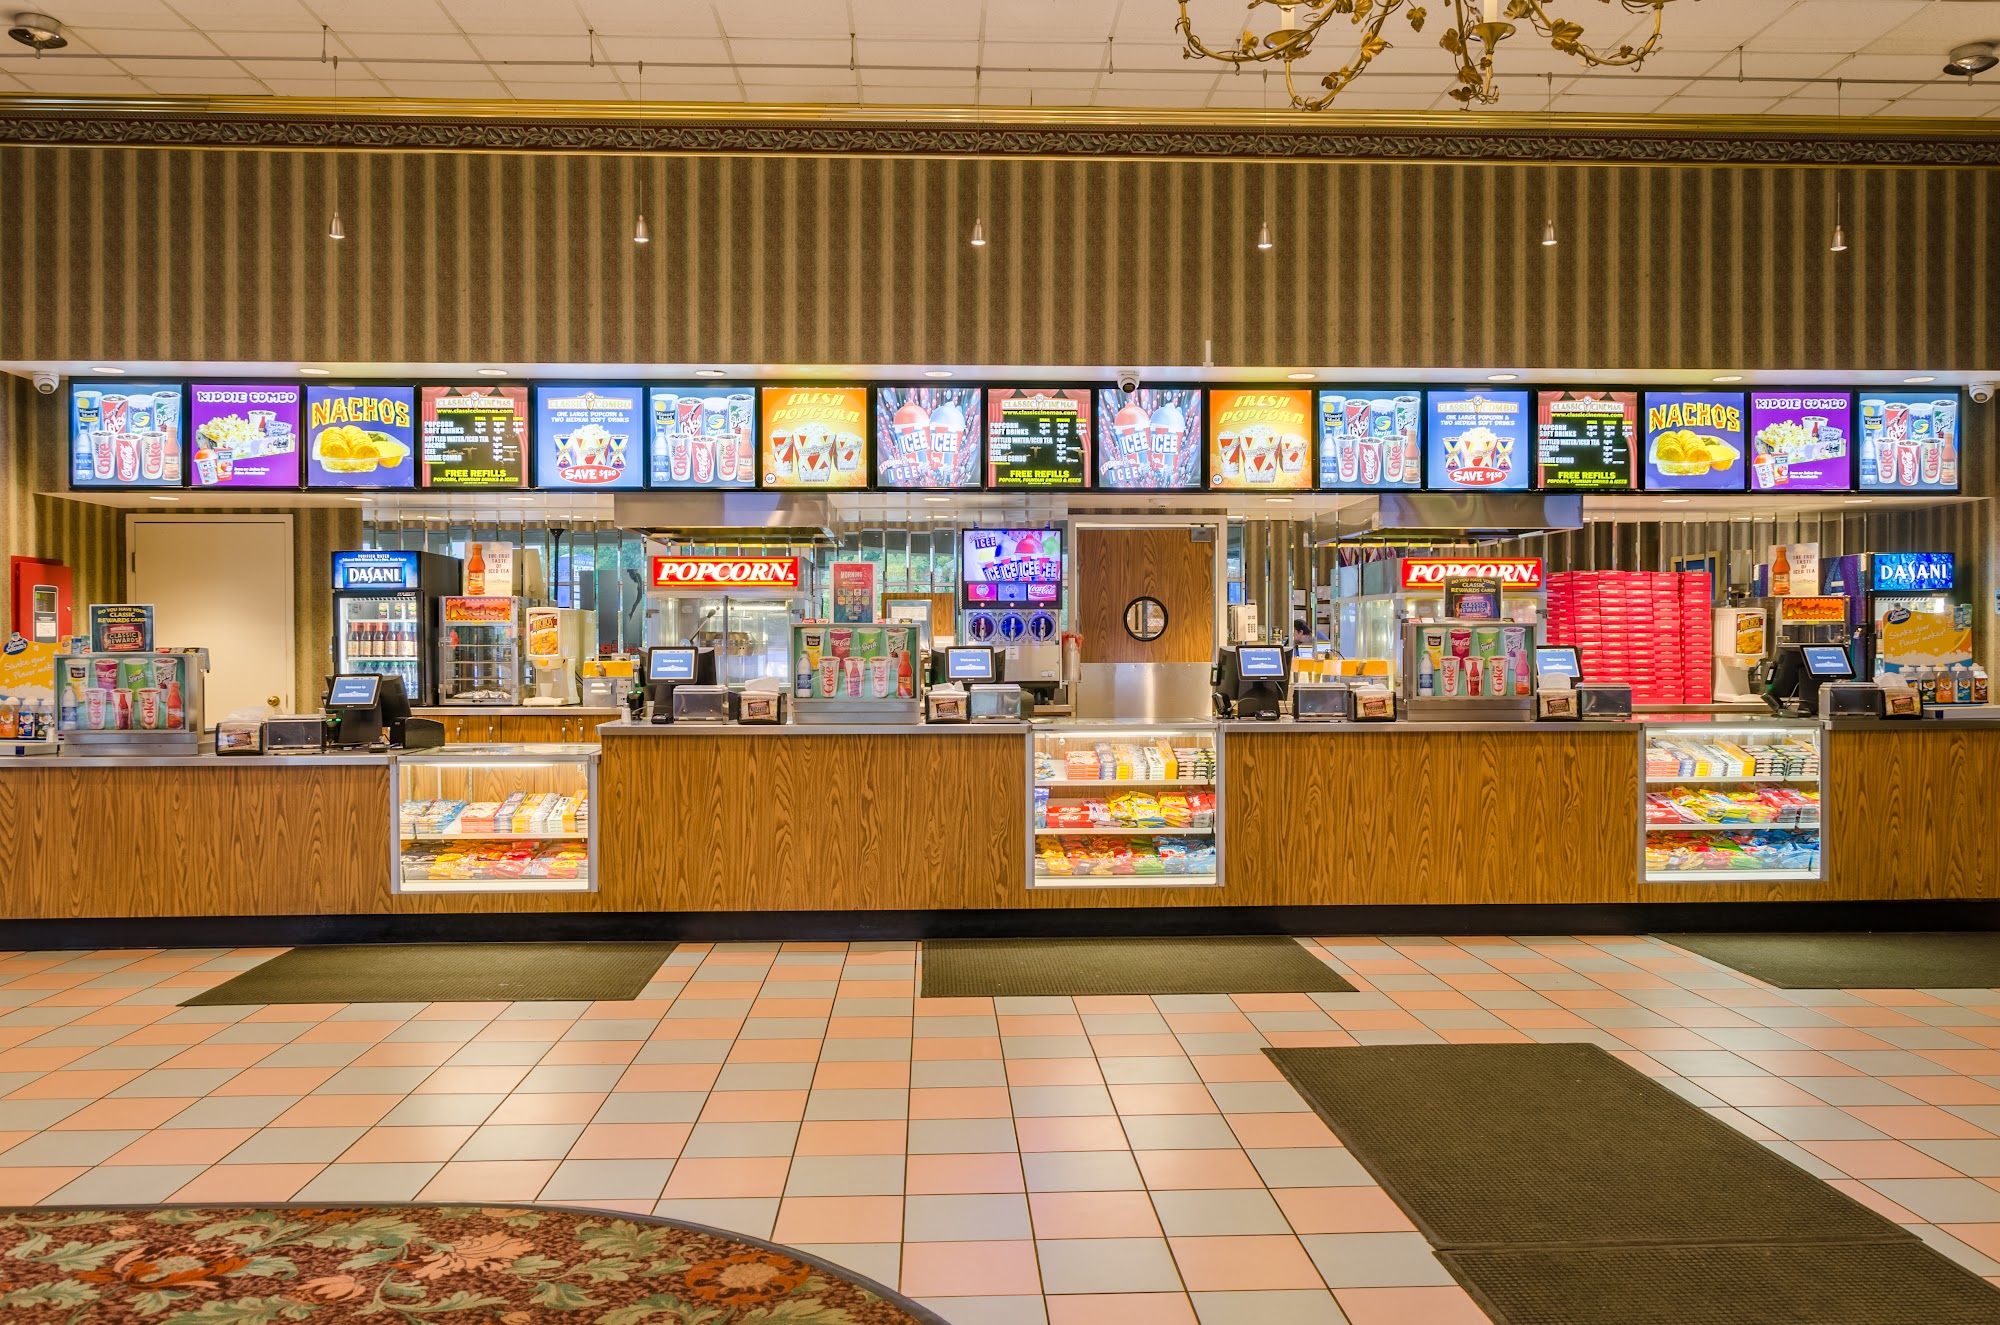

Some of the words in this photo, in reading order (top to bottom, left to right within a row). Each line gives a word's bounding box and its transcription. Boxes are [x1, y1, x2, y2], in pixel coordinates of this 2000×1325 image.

[197, 391, 247, 403] KIDDIE
[249, 391, 297, 403] COMBO
[437, 399, 471, 407] CLASSIC
[479, 399, 511, 407] CINEMAS
[549, 400, 585, 408] CLASSIC
[595, 400, 631, 408] COMBO
[787, 393, 846, 406] FRESH
[1233, 395, 1291, 409] FRESH
[1755, 399, 1801, 409] KIDDIE
[1803, 399, 1847, 409] COMBO
[311, 397, 410, 429] NACHOS
[771, 408, 860, 422] POPCORN
[1439, 404, 1473, 412] CLASSIC
[1482, 404, 1517, 412] COMBO
[1219, 409, 1305, 424] POPCORN
[1649, 402, 1740, 434] NACHOS
[900, 430, 929, 453] ICEE
[930, 432, 958, 453] ICEE
[1120, 431, 1150, 455] ICEE
[1151, 434, 1178, 454] ICEE
[97, 442, 111, 474] Coke
[146, 442, 162, 474] Coke
[674, 445, 687, 476] Coke
[721, 444, 736, 476] Coke
[1341, 447, 1354, 477] Coke
[1388, 446, 1402, 477] Coke
[1881, 449, 1893, 478] Coke
[1925, 448, 1939, 478] Coke
[445, 469, 469, 477] FREE
[470, 469, 506, 477] REFILLS
[565, 469, 597, 480] SAVE
[888, 467, 919, 481] ICEE
[1010, 469, 1033, 477] FREE
[1035, 469, 1070, 477] REFILLS
[1110, 467, 1139, 482] ICEE
[1453, 471, 1484, 481] SAVE
[975, 536, 996, 550] ICEE
[657, 562, 792, 581] POPCORN
[840, 571, 863, 579] MORNING
[1019, 560, 1040, 577] ICEE
[1407, 564, 1536, 582] POPCORN
[1881, 560, 1947, 583] DASANI
[450, 602, 506, 619] Nachos
[1787, 601, 1839, 617] Nachos
[1888, 627, 1914, 640] Shake
[1915, 624, 1930, 636] your
[1922, 628, 1946, 641] maker!
[861, 641, 878, 652] Sprite
[1480, 641, 1496, 652] Sprite
[3, 658, 30, 671] Shake
[31, 656, 46, 668] your
[128, 672, 145, 683] Sprite
[823, 666, 834, 694] Coke
[874, 667, 885, 694] Coke
[1444, 665, 1455, 693] Coke
[1493, 665, 1503, 692] Coke
[91, 698, 101, 726] Coke
[144, 698, 154, 725] Coke
